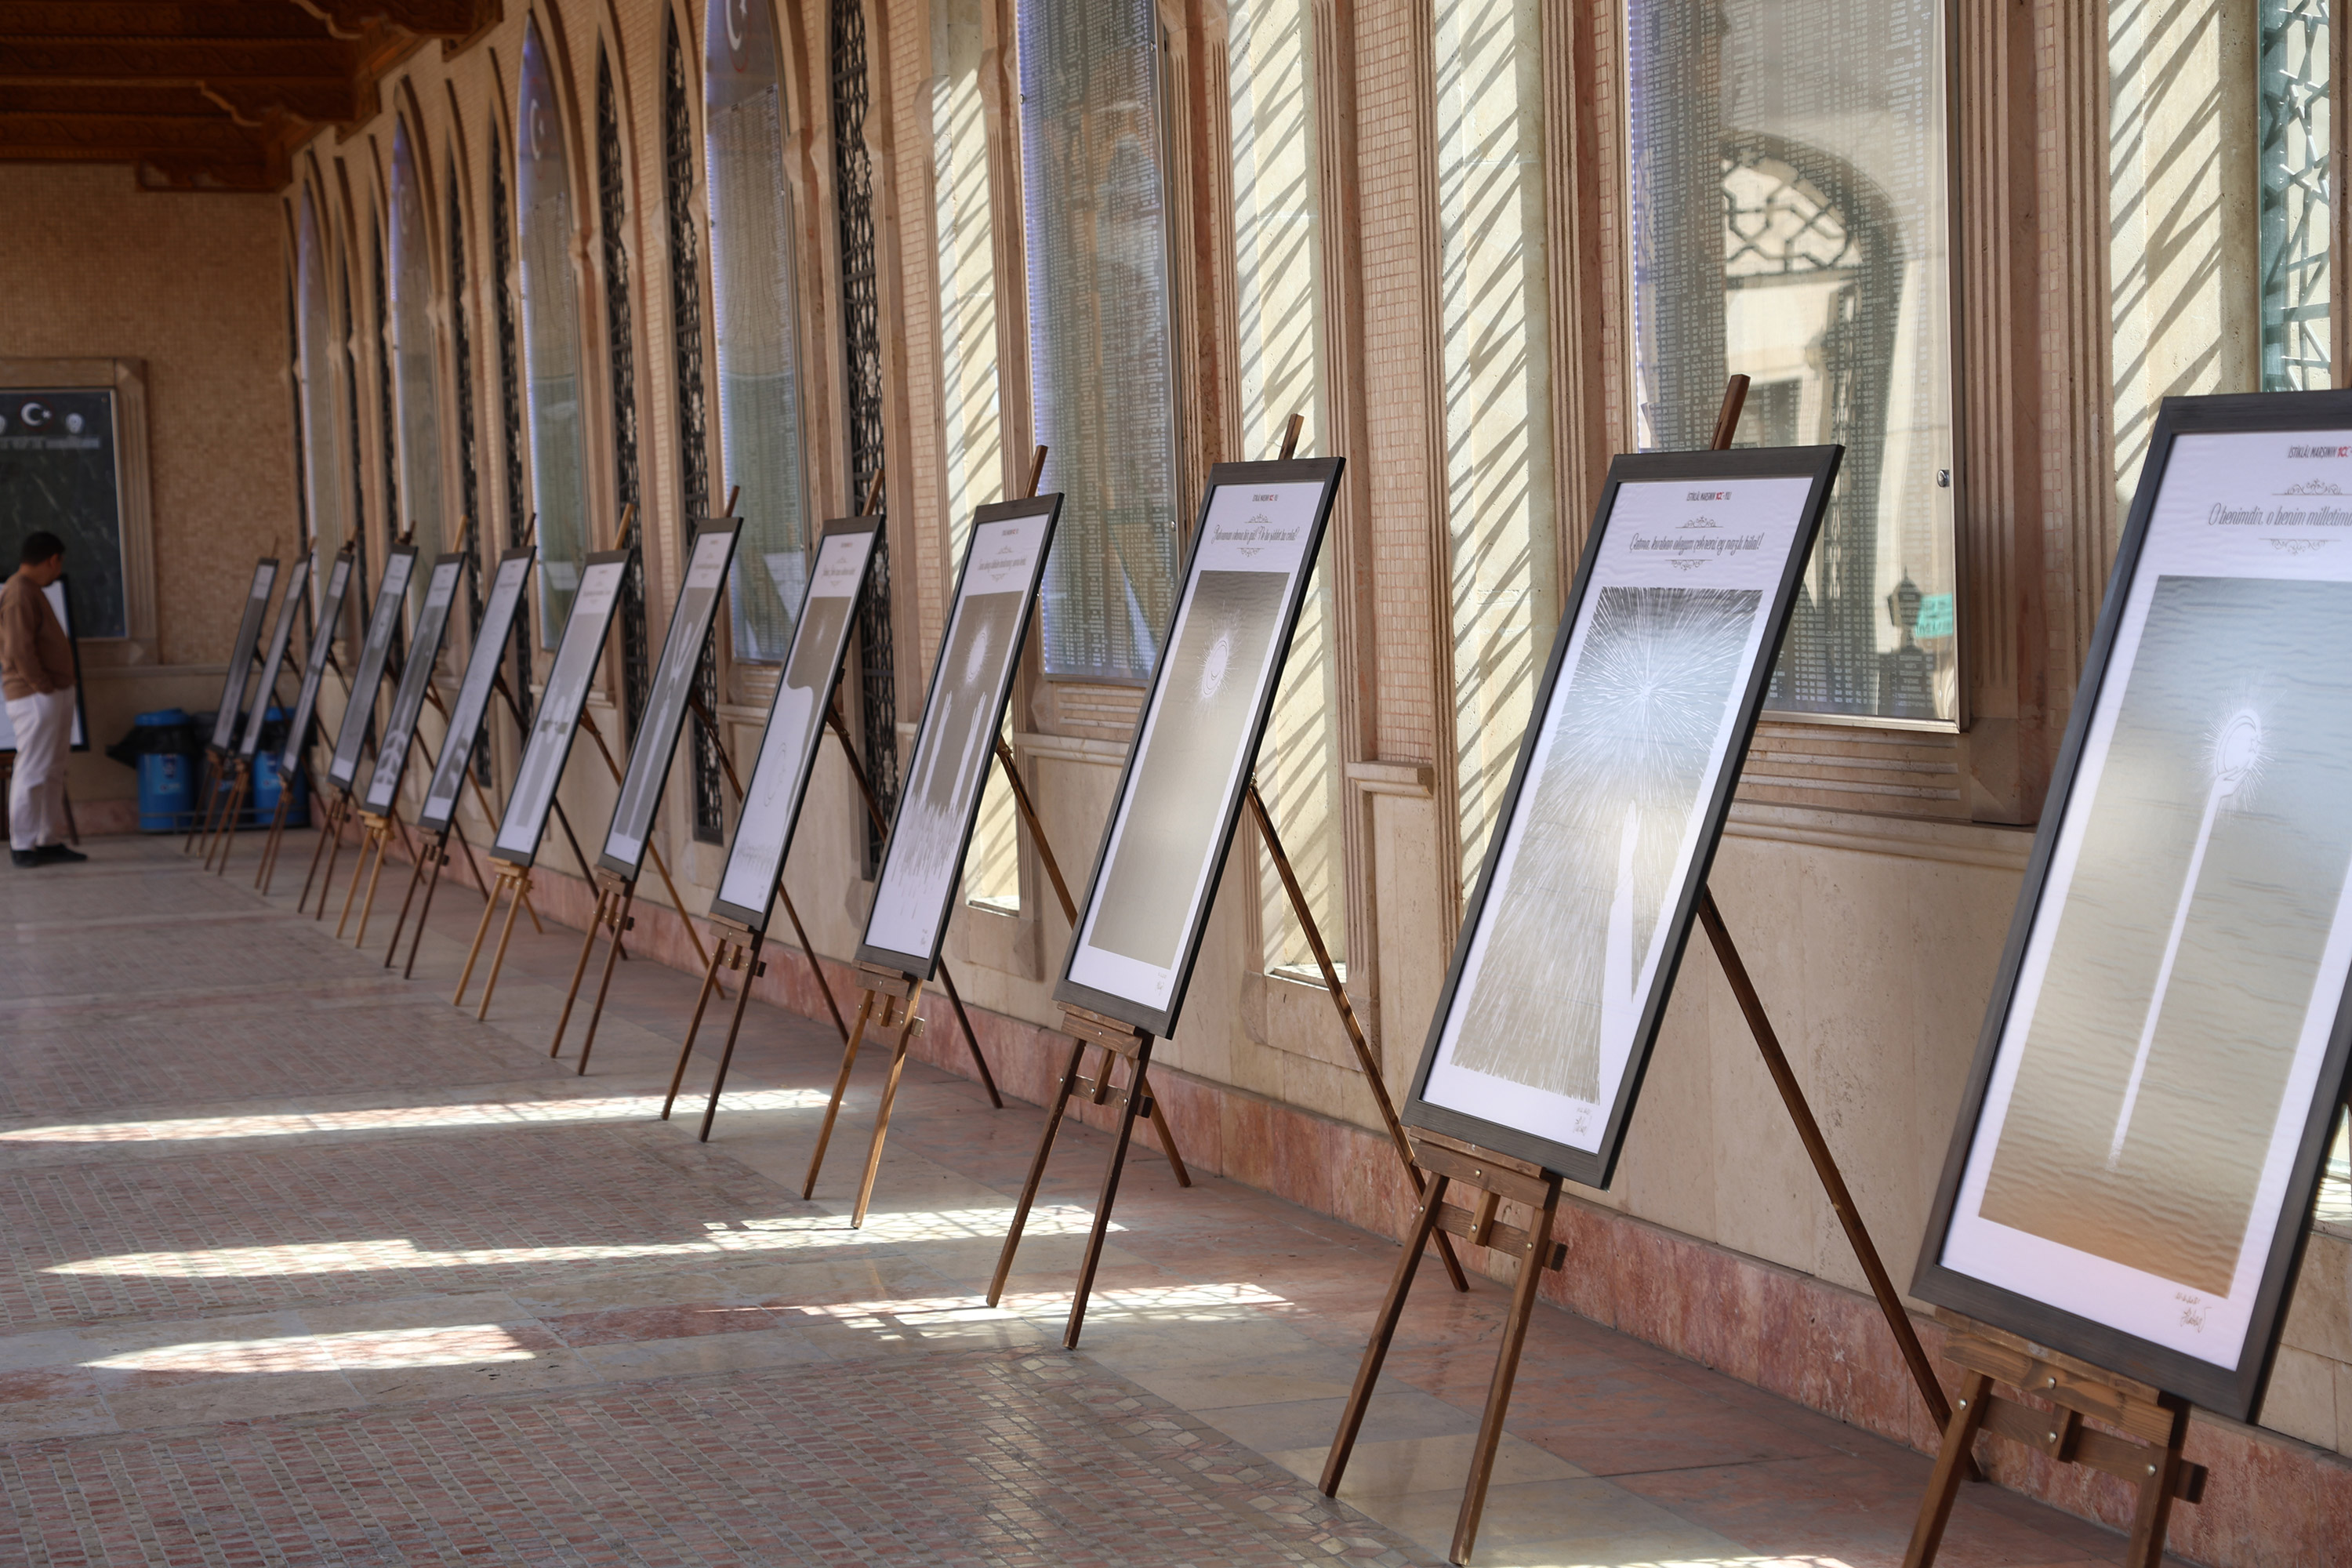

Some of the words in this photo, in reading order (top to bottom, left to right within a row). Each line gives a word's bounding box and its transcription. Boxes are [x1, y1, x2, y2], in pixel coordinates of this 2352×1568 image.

[2209, 503, 2222, 526] O
[2266, 511, 2275, 526] o
[2274, 506, 2307, 526] benim
